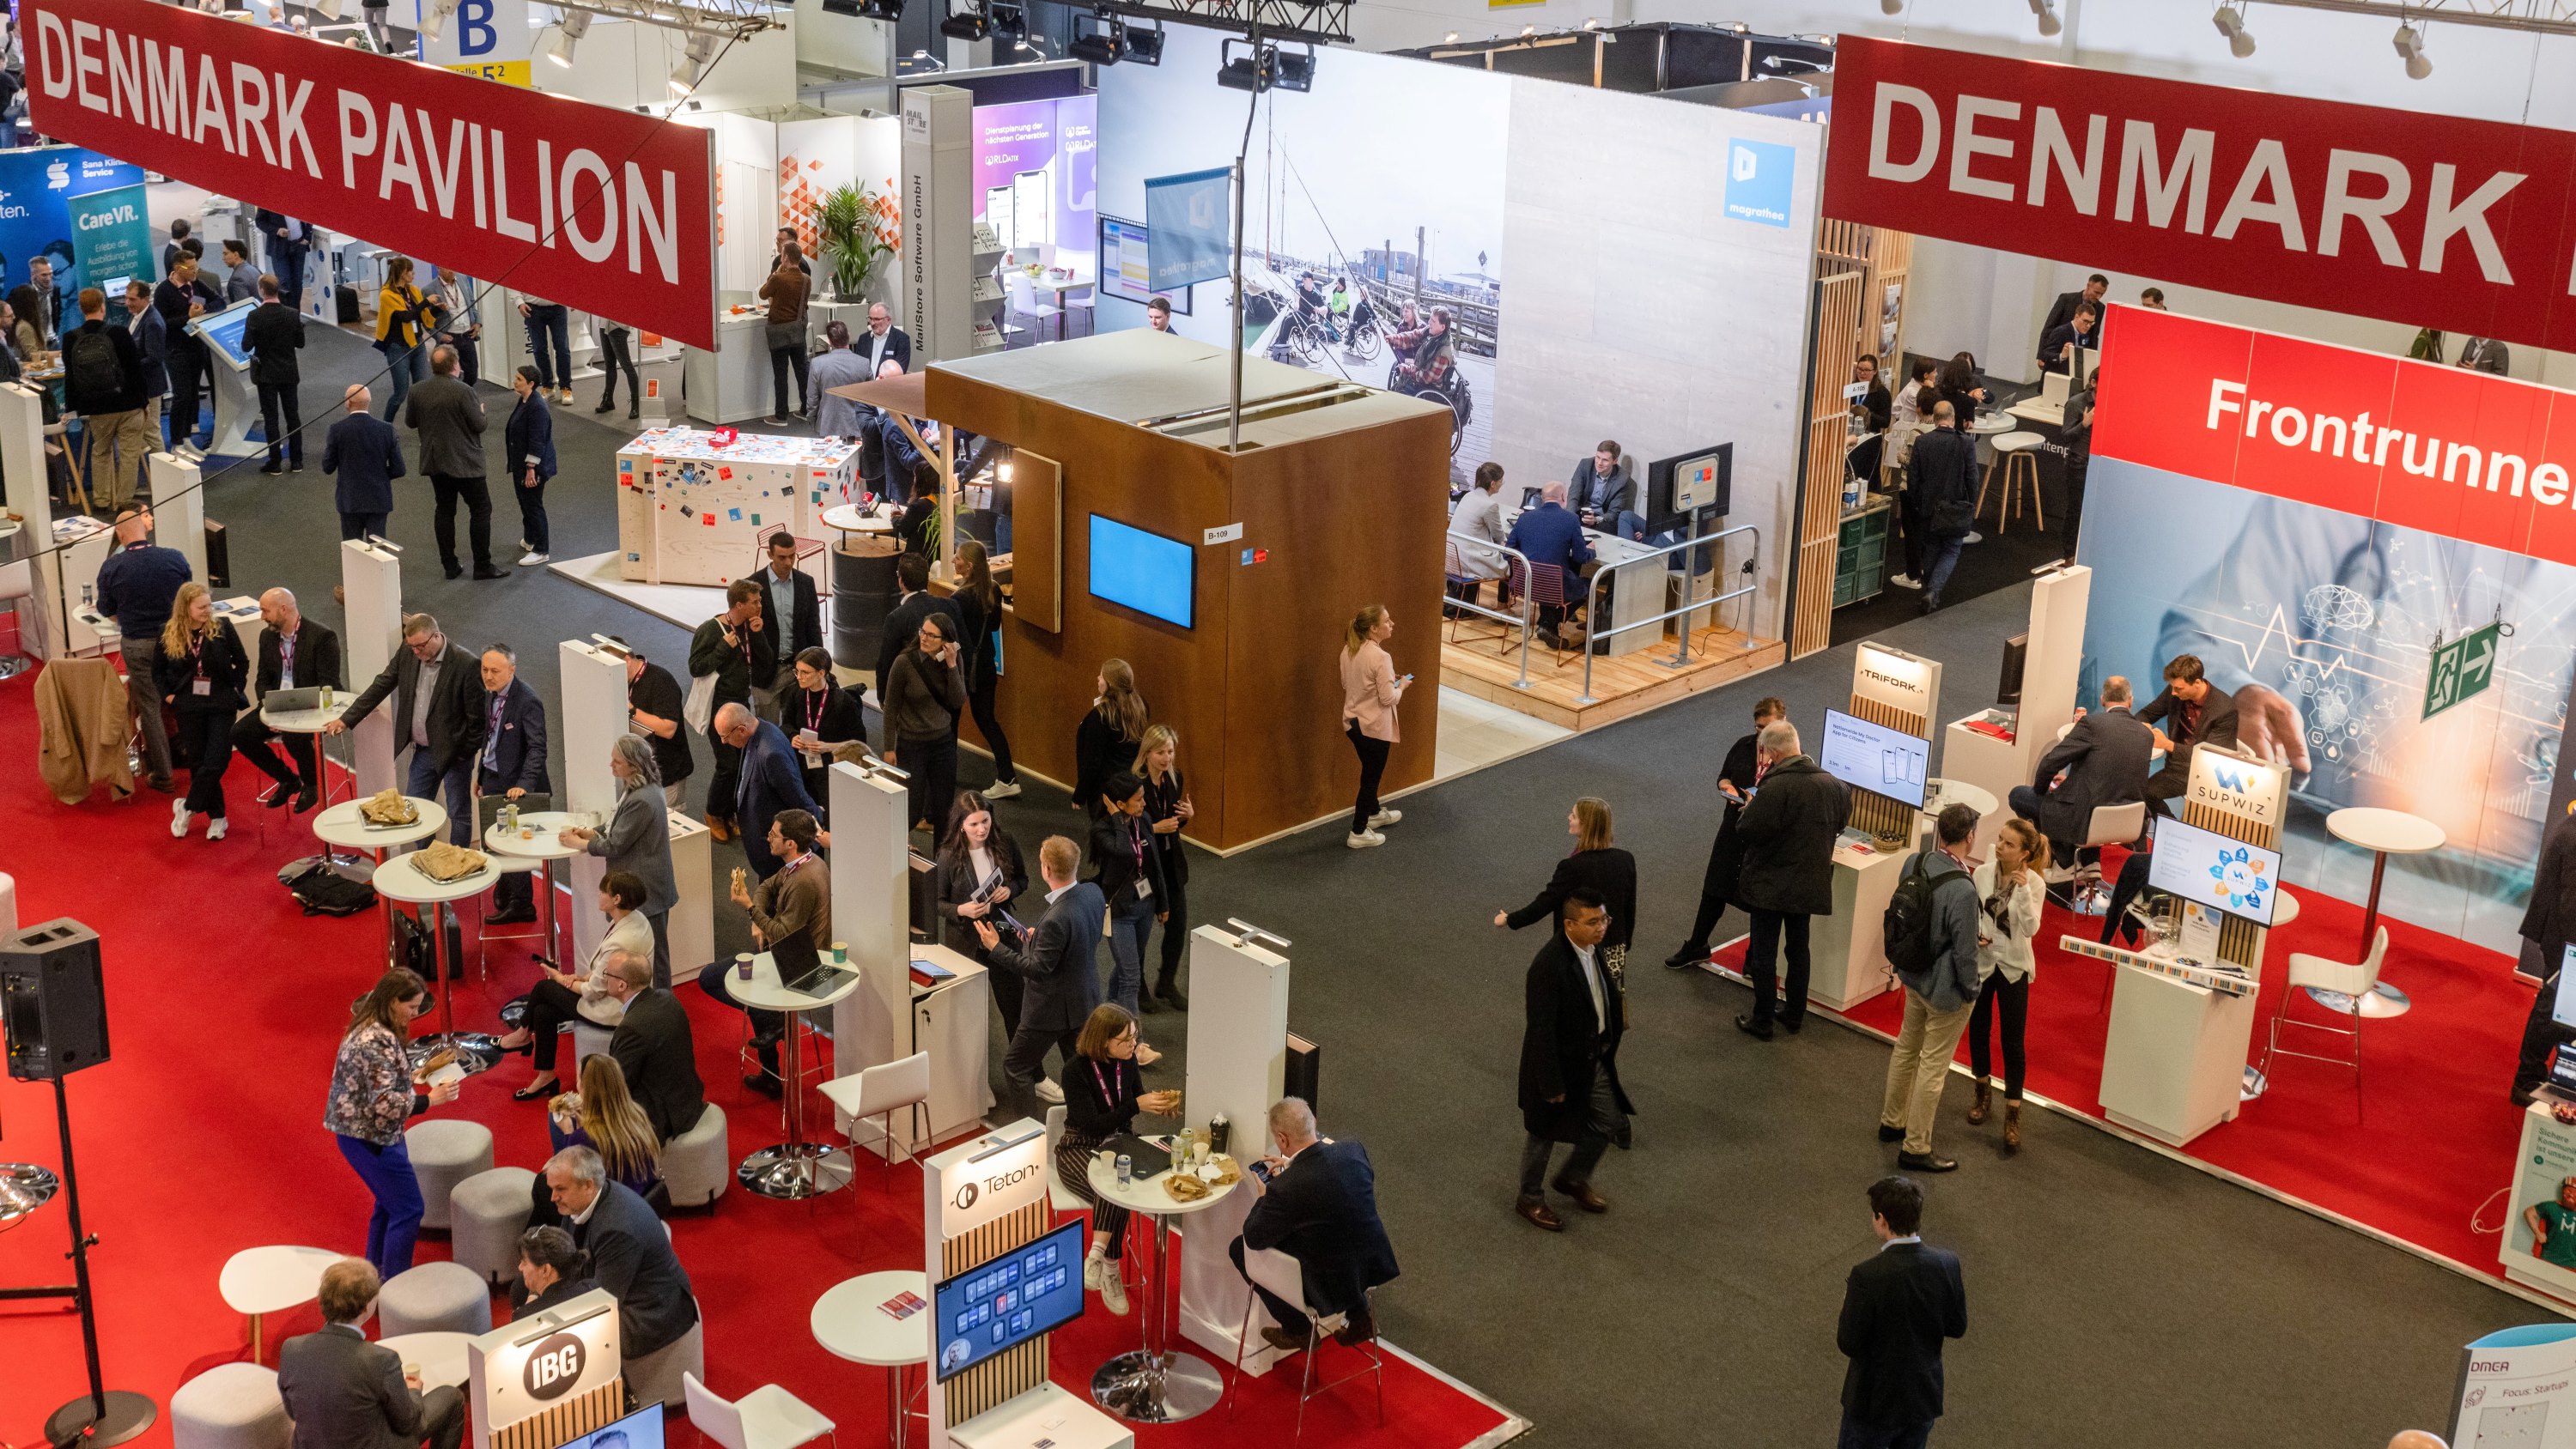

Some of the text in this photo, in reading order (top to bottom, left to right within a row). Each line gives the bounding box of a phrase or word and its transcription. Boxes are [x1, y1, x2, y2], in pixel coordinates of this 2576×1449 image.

[458, 0, 497, 57] B
[906, 110, 922, 119] MAIL
[985, 124, 1031, 135] Dienstplanung
[985, 131, 1049, 145] nächsten Generation
[36, 9, 679, 284] DENMARK PAVILION
[82, 161, 103, 169] Sana
[82, 168, 114, 179] Service
[1868, 82, 2528, 286] DENMARK
[78, 204, 138, 231] CareVR.
[1729, 203, 1784, 221] magrathea
[87, 252, 125, 266] Ausbildung
[914, 175, 924, 352] MailStore Software GmbH
[89, 261, 138, 276] morgen schon
[2206, 378, 2576, 511] Frontrunne
[1208, 530, 1228, 539] B-109
[1832, 730, 1842, 738] App
[1848, 734, 1867, 744] Citizens
[1858, 730, 1865, 738] My
[1865, 733, 1880, 743] Doctor
[2198, 786, 2265, 816] SUPWIZ
[2539, 1127, 2569, 1143] Sichere
[2536, 1145, 2574, 1163] ist unsere
[983, 1163, 1036, 1195] Teton
[532, 1344, 577, 1391] IBG
[2502, 1379, 2569, 1397] Focus: Startups
